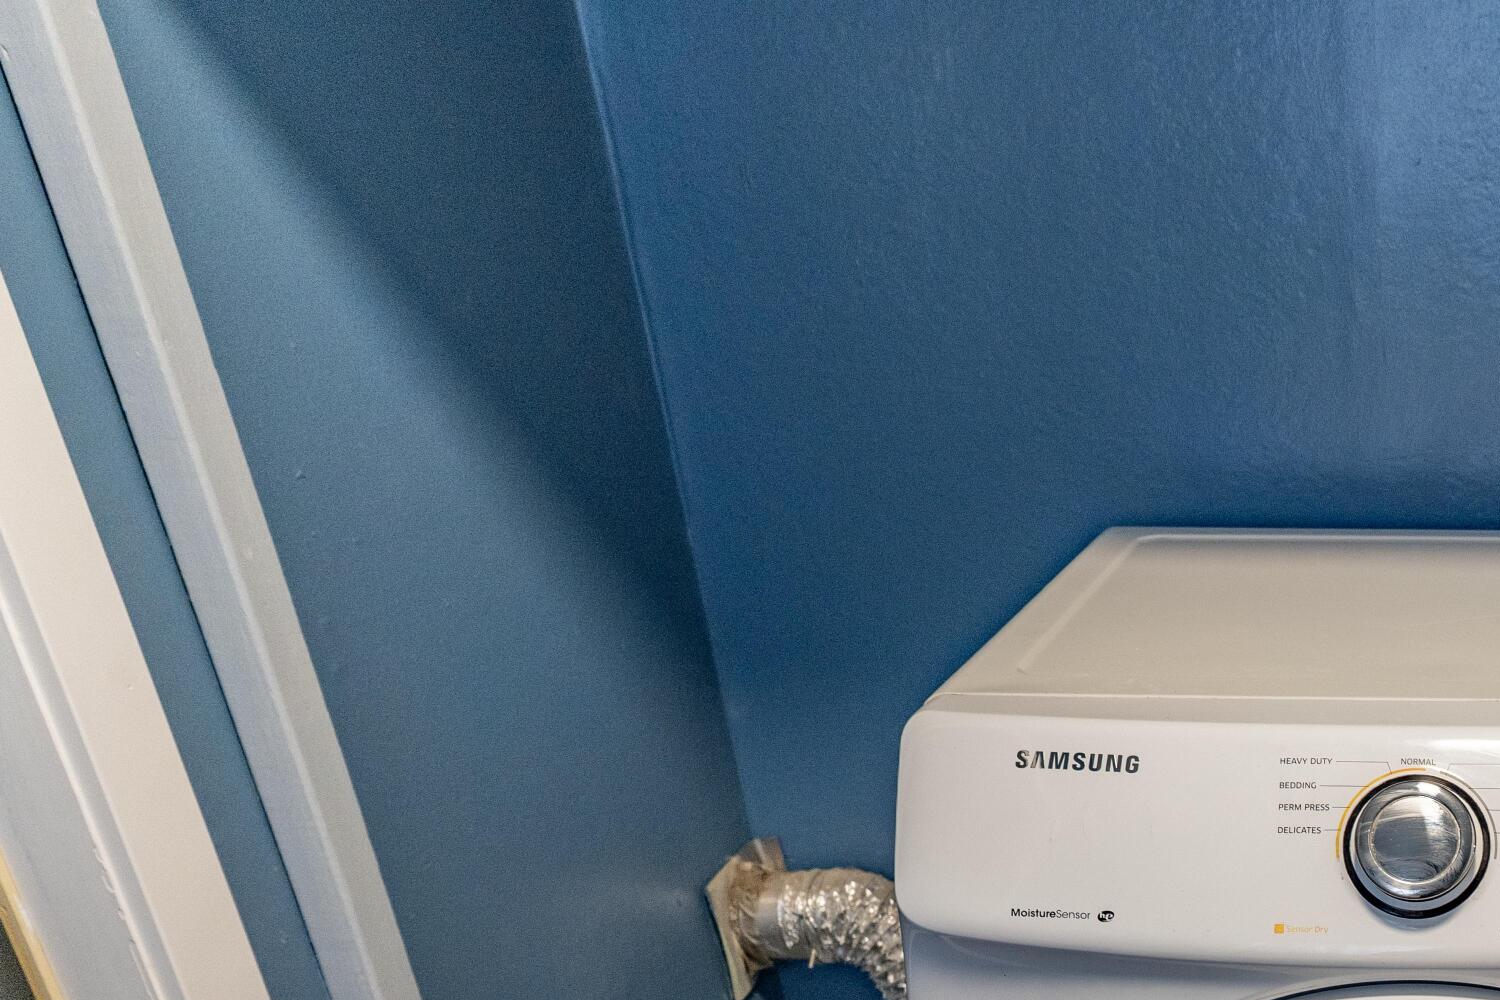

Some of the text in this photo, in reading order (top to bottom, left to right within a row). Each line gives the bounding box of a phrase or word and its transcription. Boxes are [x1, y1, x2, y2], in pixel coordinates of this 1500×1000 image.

[1015, 750, 1140, 774] SAMSUNG
[1280, 757, 1333, 765] HEAVY DUTY
[1401, 758, 1436, 766] NORMAL
[1278, 803, 1330, 811] PERM PRESS
[1277, 826, 1322, 834] DELICATES
[1010, 908, 1091, 920] MoistureSensor
[1314, 926, 1329, 934] Dry
